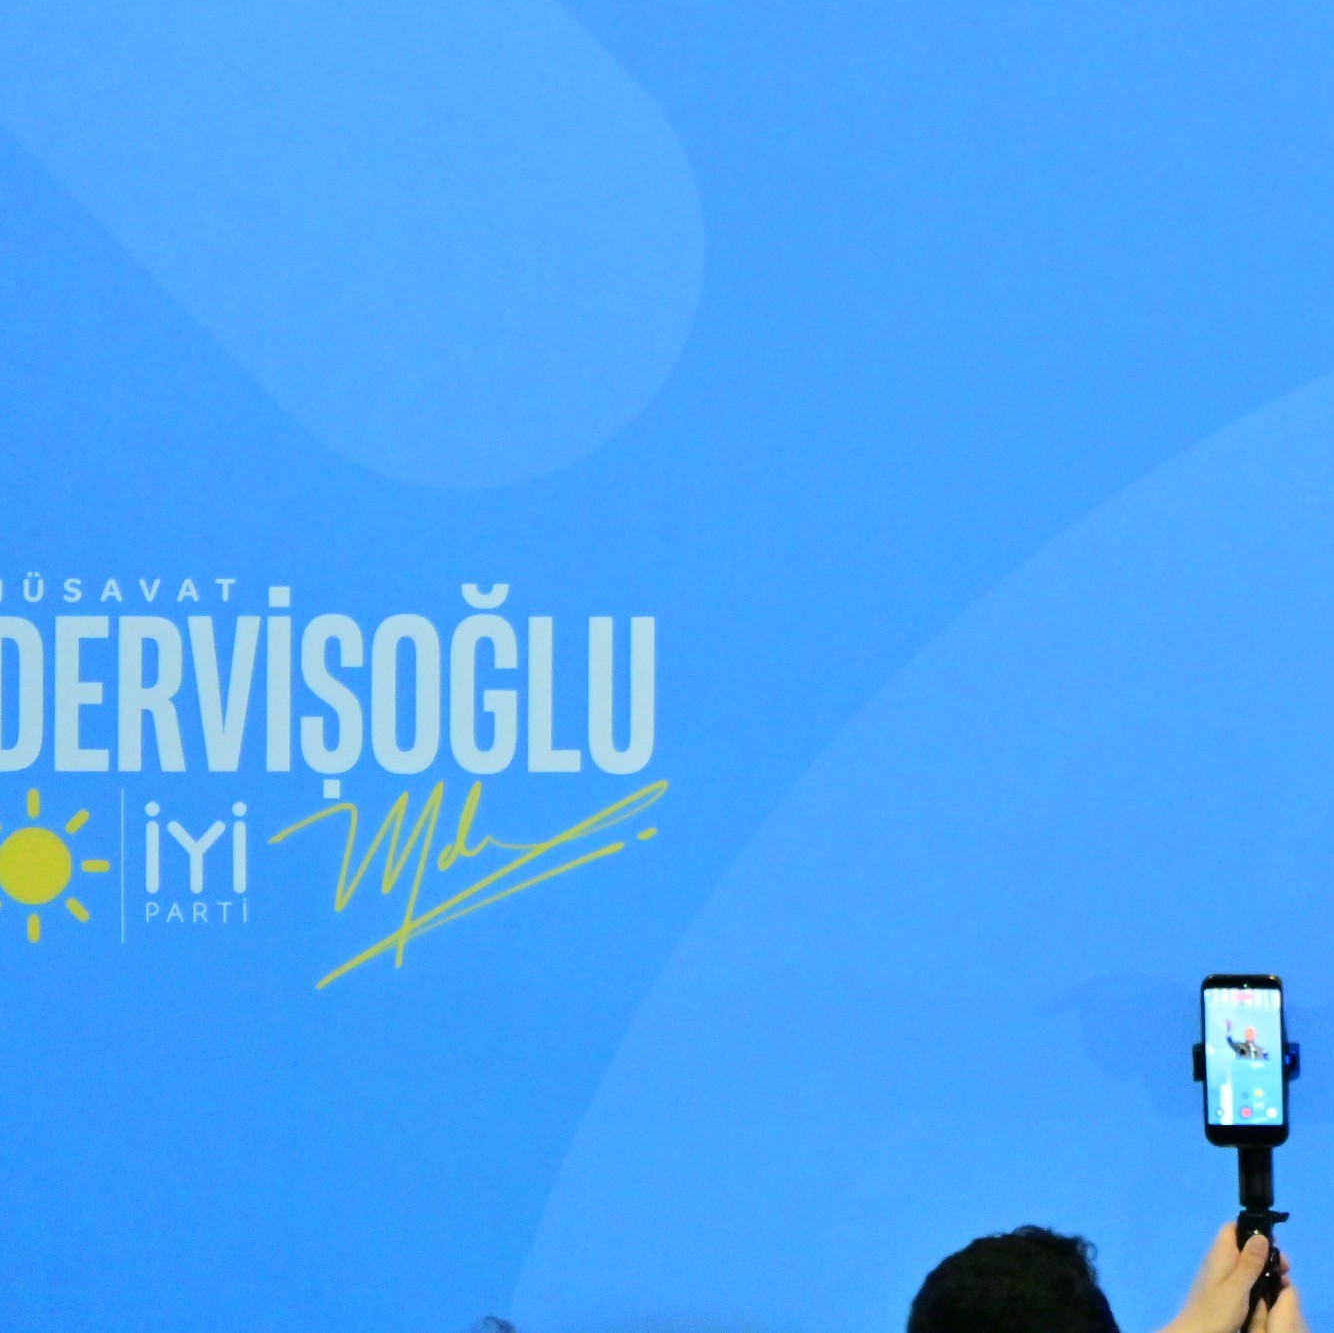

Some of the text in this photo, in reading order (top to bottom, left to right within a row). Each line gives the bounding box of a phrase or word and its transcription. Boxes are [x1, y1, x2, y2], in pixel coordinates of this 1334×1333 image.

[0, 571, 237, 602] ÜSAVAT
[0, 583, 656, 799] DERVİŞOĞLU
[145, 801, 248, 894] İYİ
[145, 898, 248, 924] PARTİ
